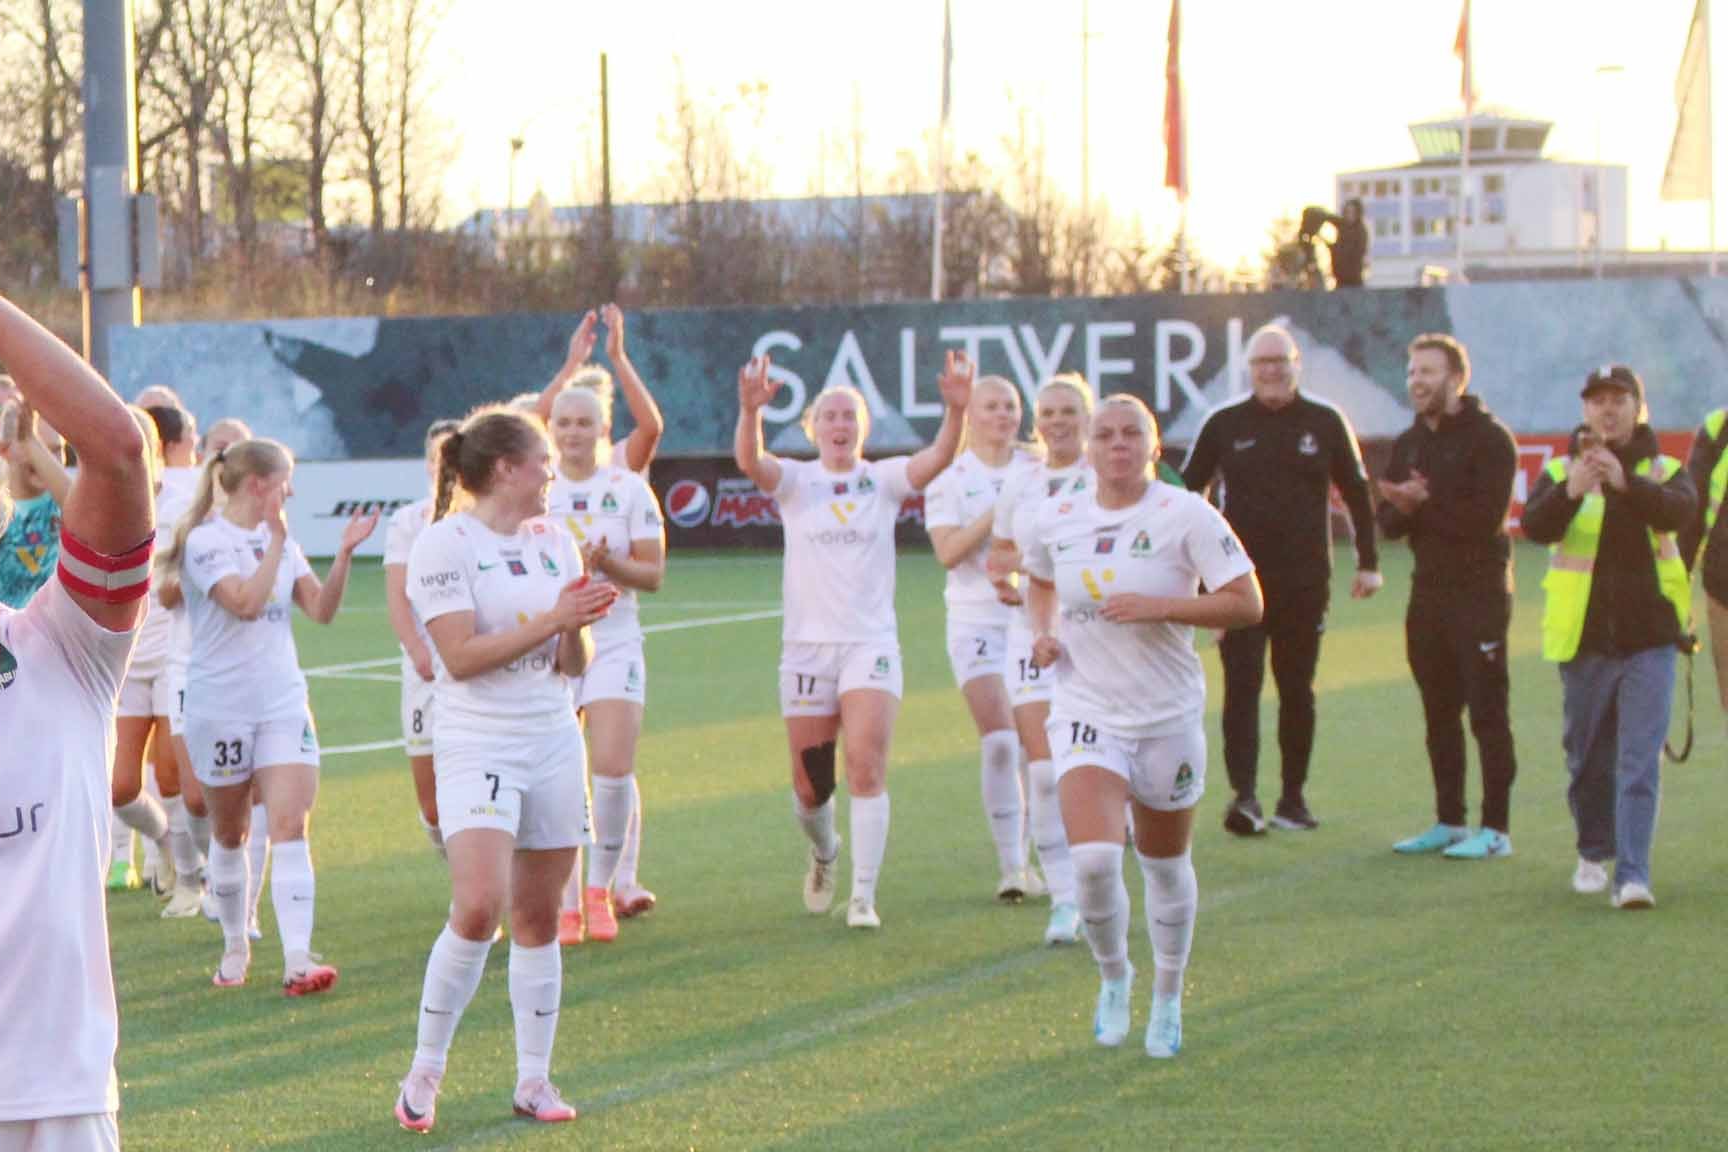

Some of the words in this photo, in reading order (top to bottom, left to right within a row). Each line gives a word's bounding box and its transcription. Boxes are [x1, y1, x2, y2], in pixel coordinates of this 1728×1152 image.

[413, 709, 423, 734] 8
[214, 738, 243, 767] 33
[485, 772, 500, 801] 7
